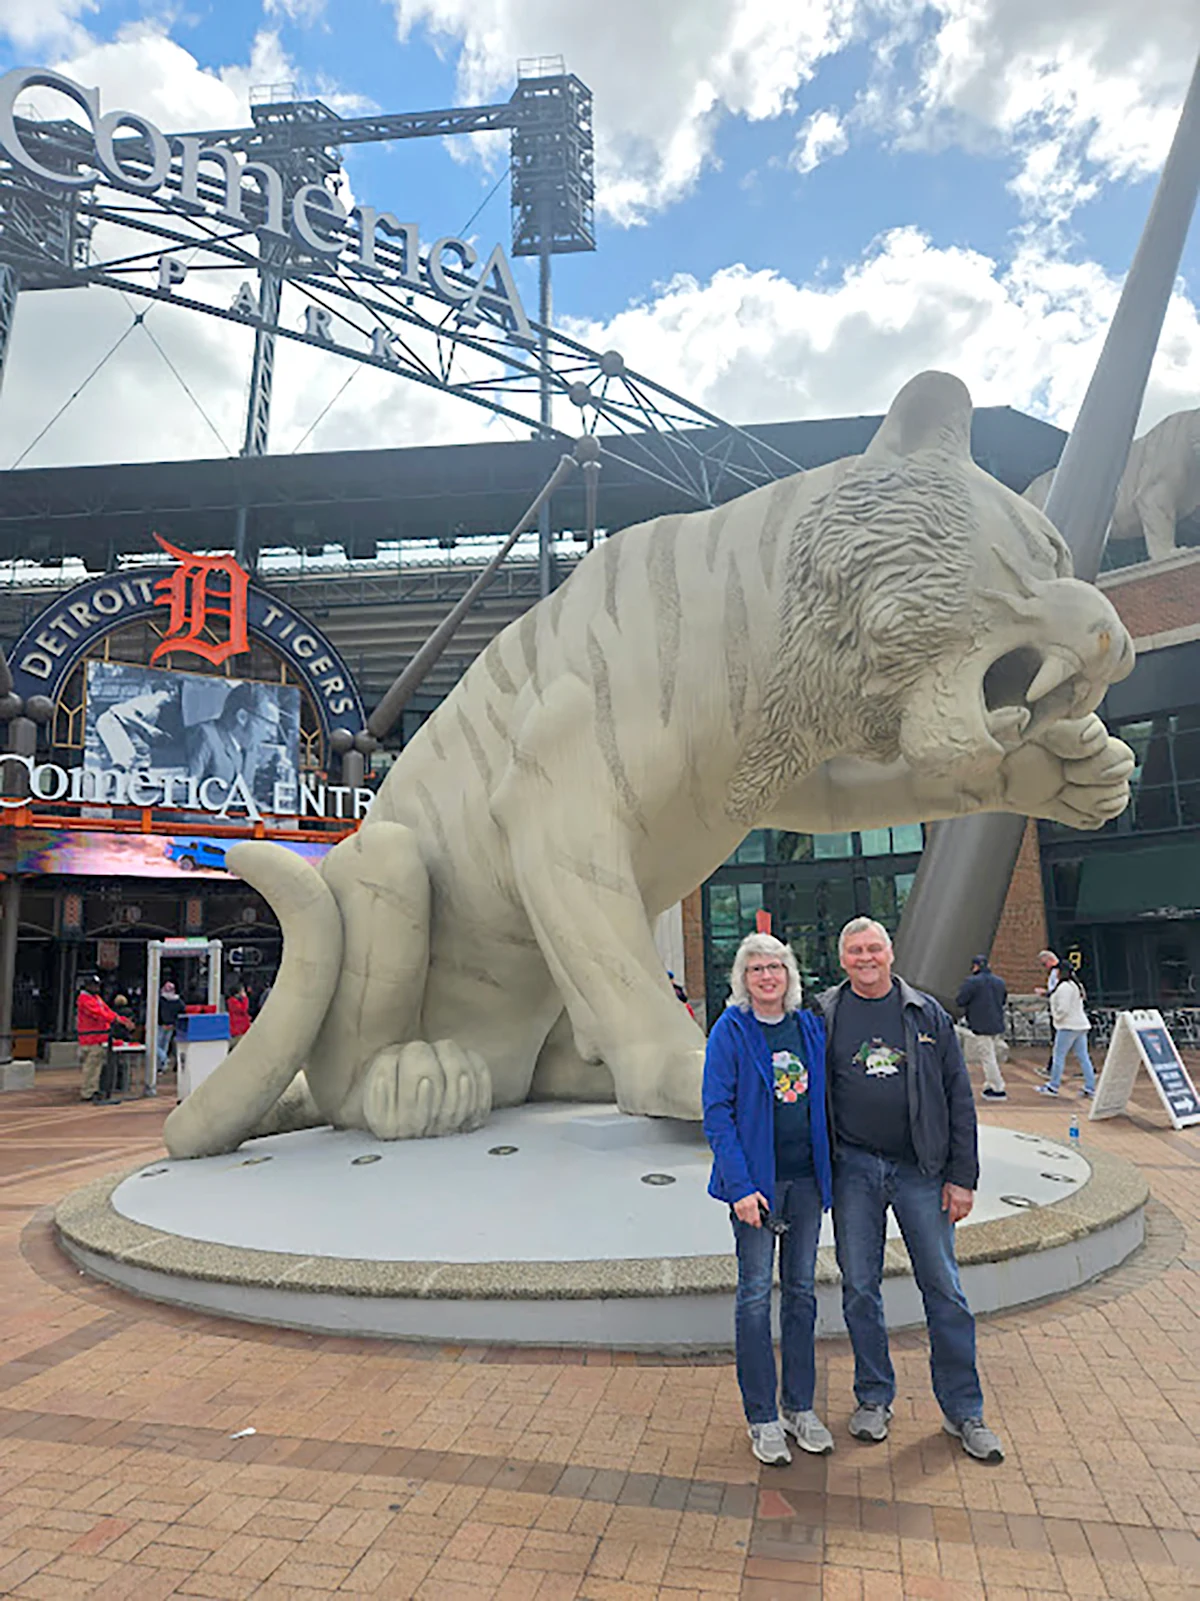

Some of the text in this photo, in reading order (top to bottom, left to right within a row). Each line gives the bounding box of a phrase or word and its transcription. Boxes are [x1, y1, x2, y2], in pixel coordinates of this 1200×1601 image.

[157, 255, 401, 367] PARK
[19, 578, 355, 716] DETROIT TIGERS
[150, 531, 250, 666] D
